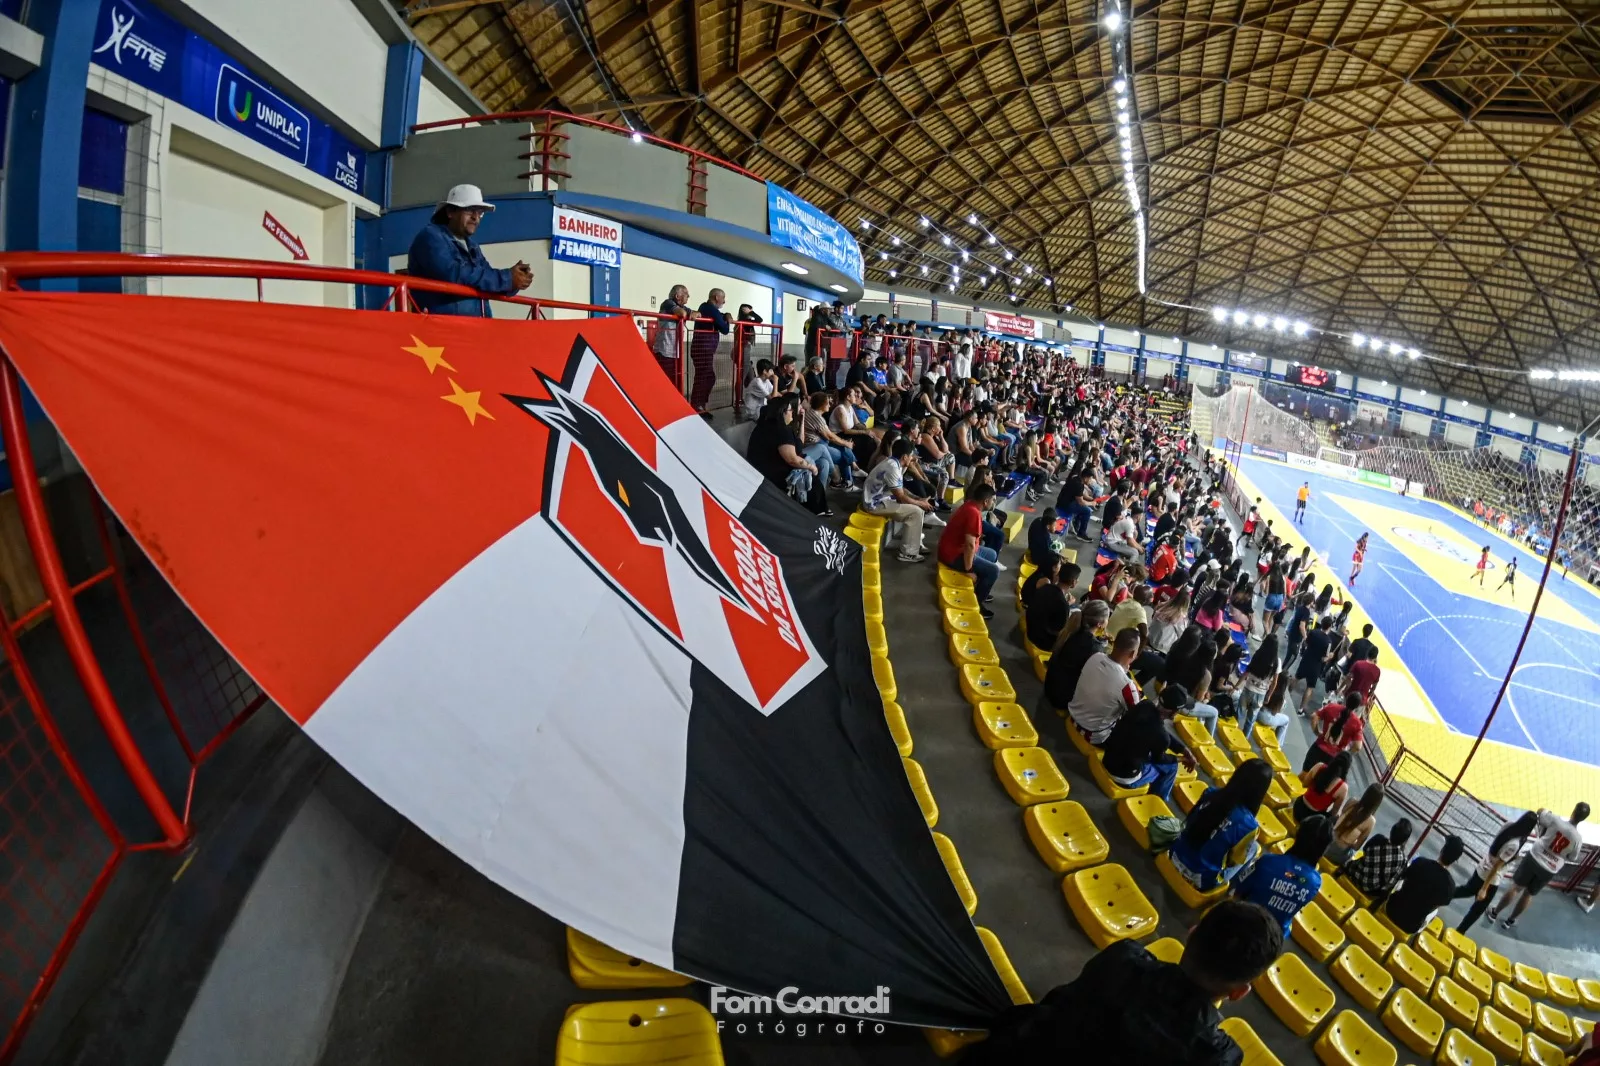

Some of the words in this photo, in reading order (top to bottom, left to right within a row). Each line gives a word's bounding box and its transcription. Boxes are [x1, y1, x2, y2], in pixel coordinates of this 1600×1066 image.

[257, 101, 302, 142] UNIPLAC
[334, 167, 358, 190] LAGES
[265, 216, 276, 231] WC
[275, 227, 304, 257] FEMININO
[558, 215, 618, 241] BANHEIRO
[557, 239, 618, 265] FEMININO
[728, 519, 770, 613] LEOAS
[753, 546, 787, 617] SERRA
[772, 612, 801, 652] DA
[1270, 878, 1309, 902] LAGES-SC
